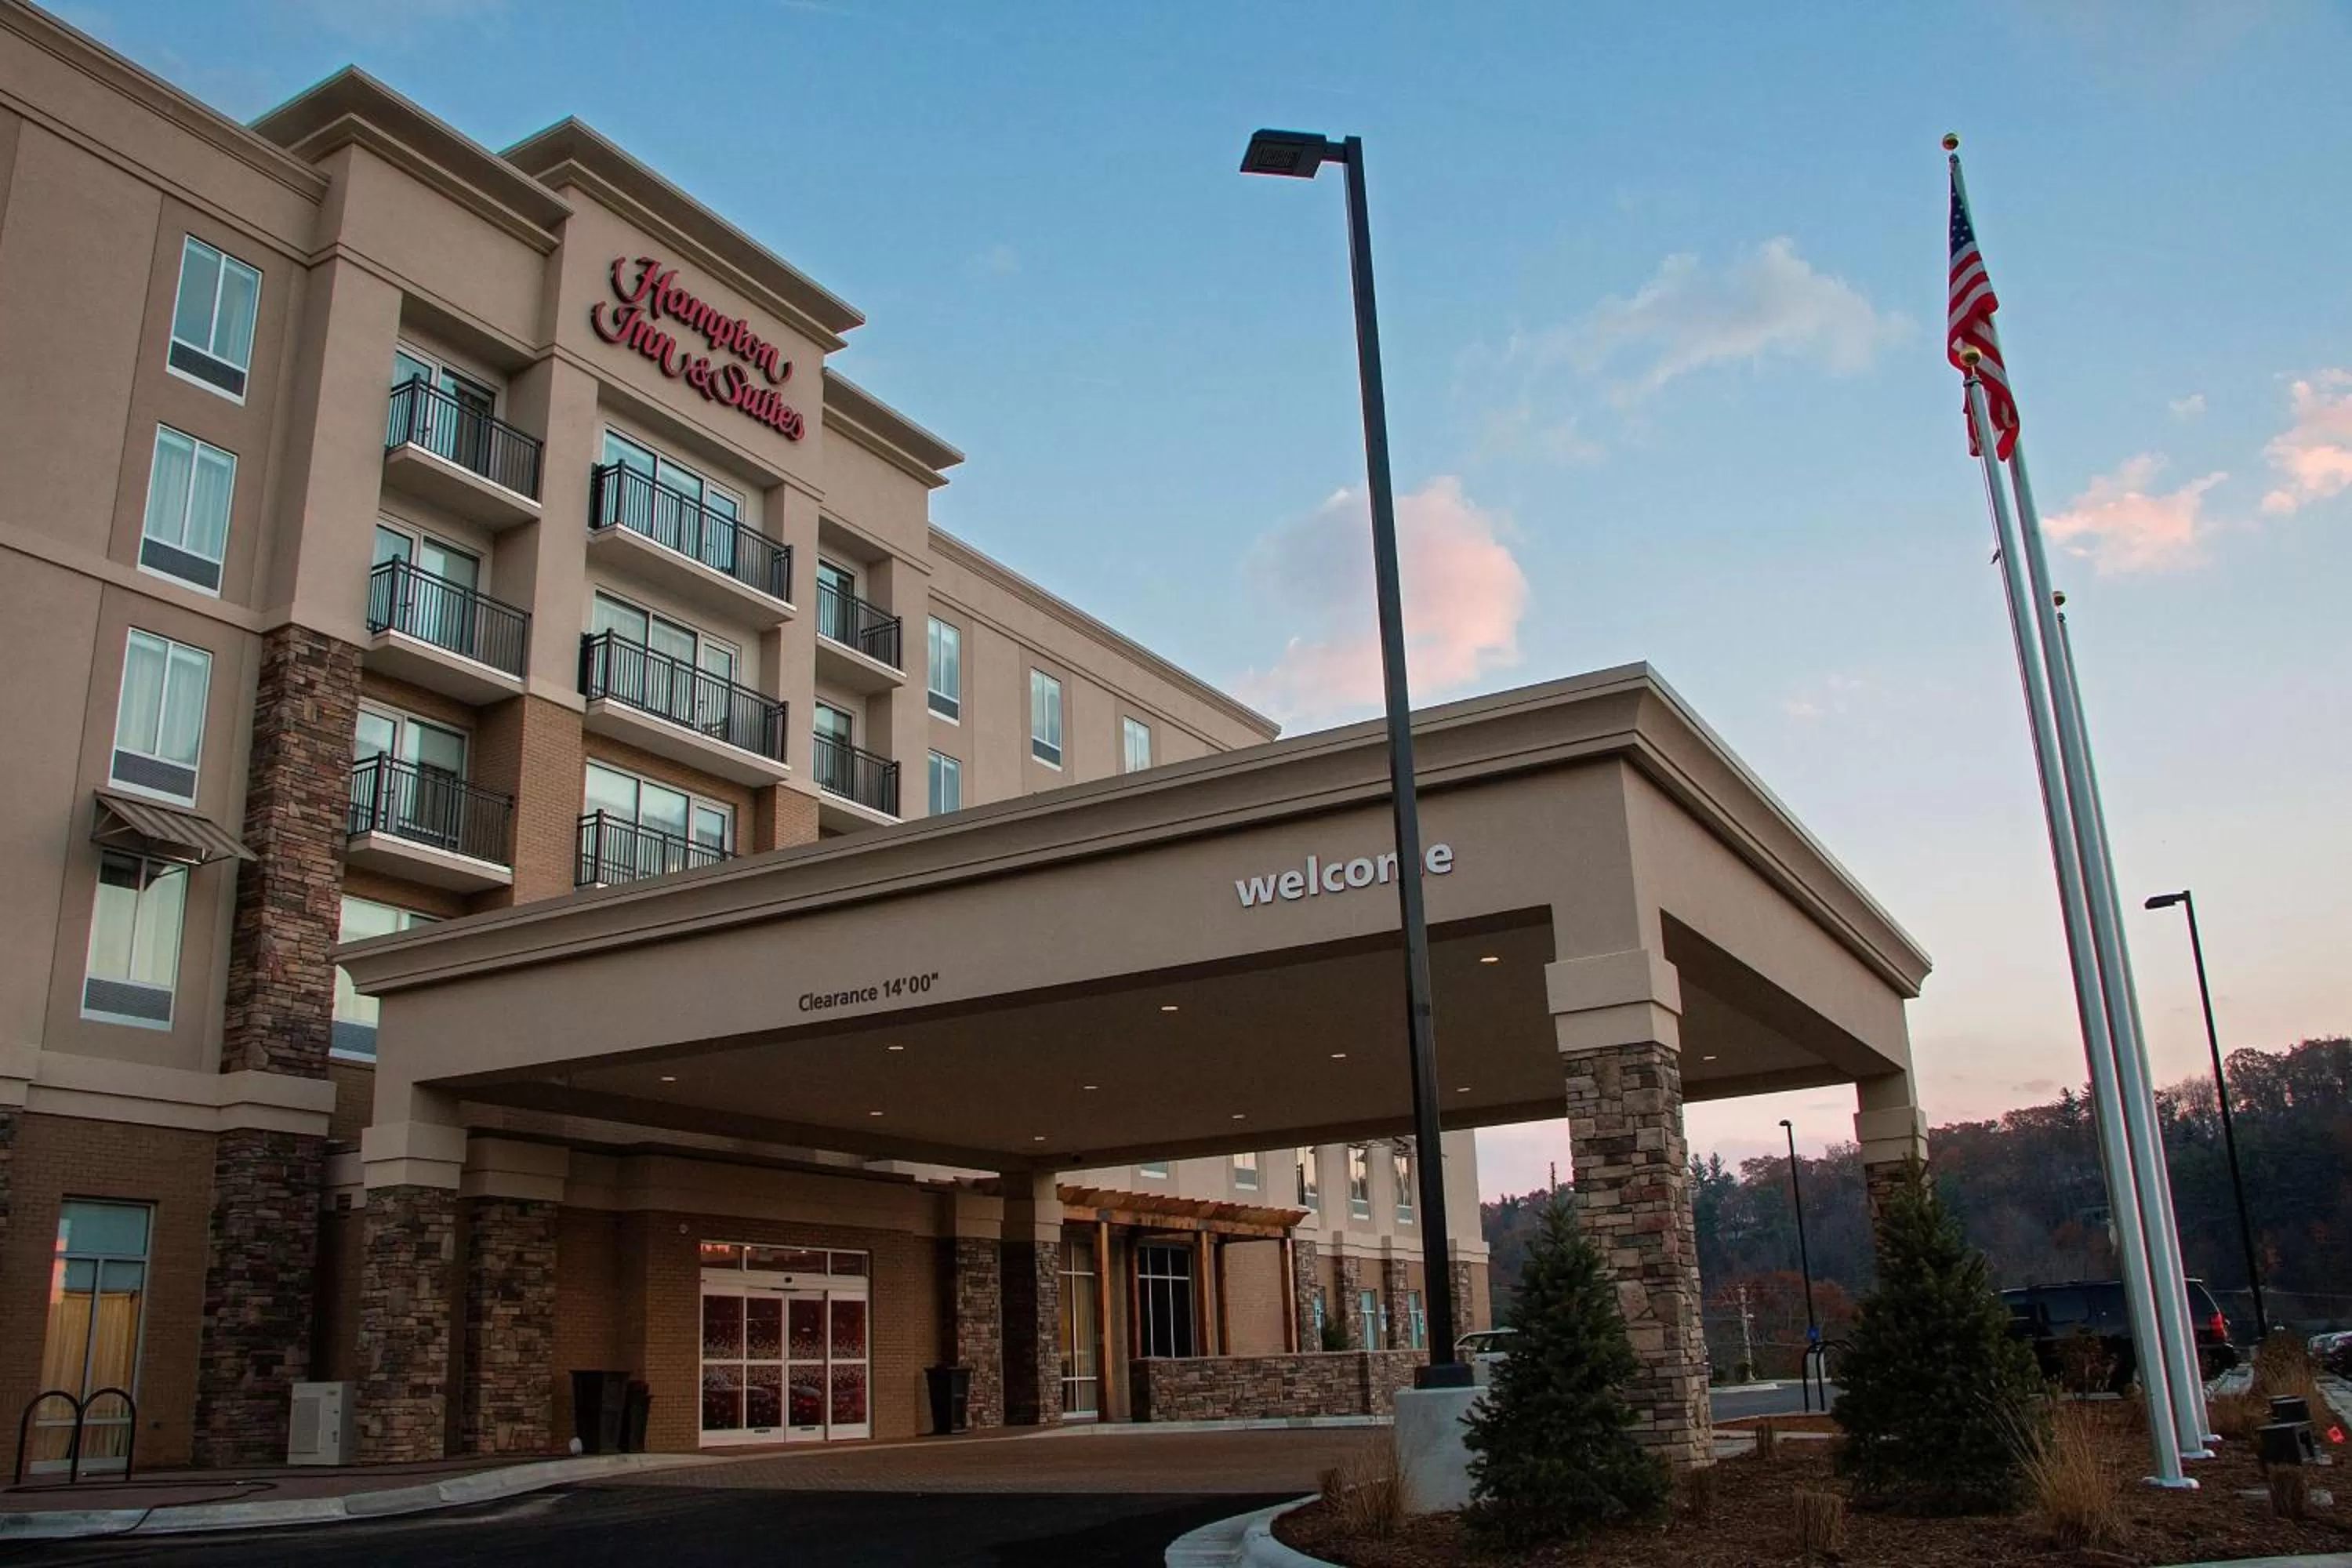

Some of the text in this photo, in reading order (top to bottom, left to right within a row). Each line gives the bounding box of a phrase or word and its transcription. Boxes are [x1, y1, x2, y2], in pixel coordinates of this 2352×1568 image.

[591, 301, 691, 379] Inn
[709, 363, 806, 442] Suites
[611, 256, 793, 385] Hampton
[798, 972, 939, 1012] Clearance 14'00"
